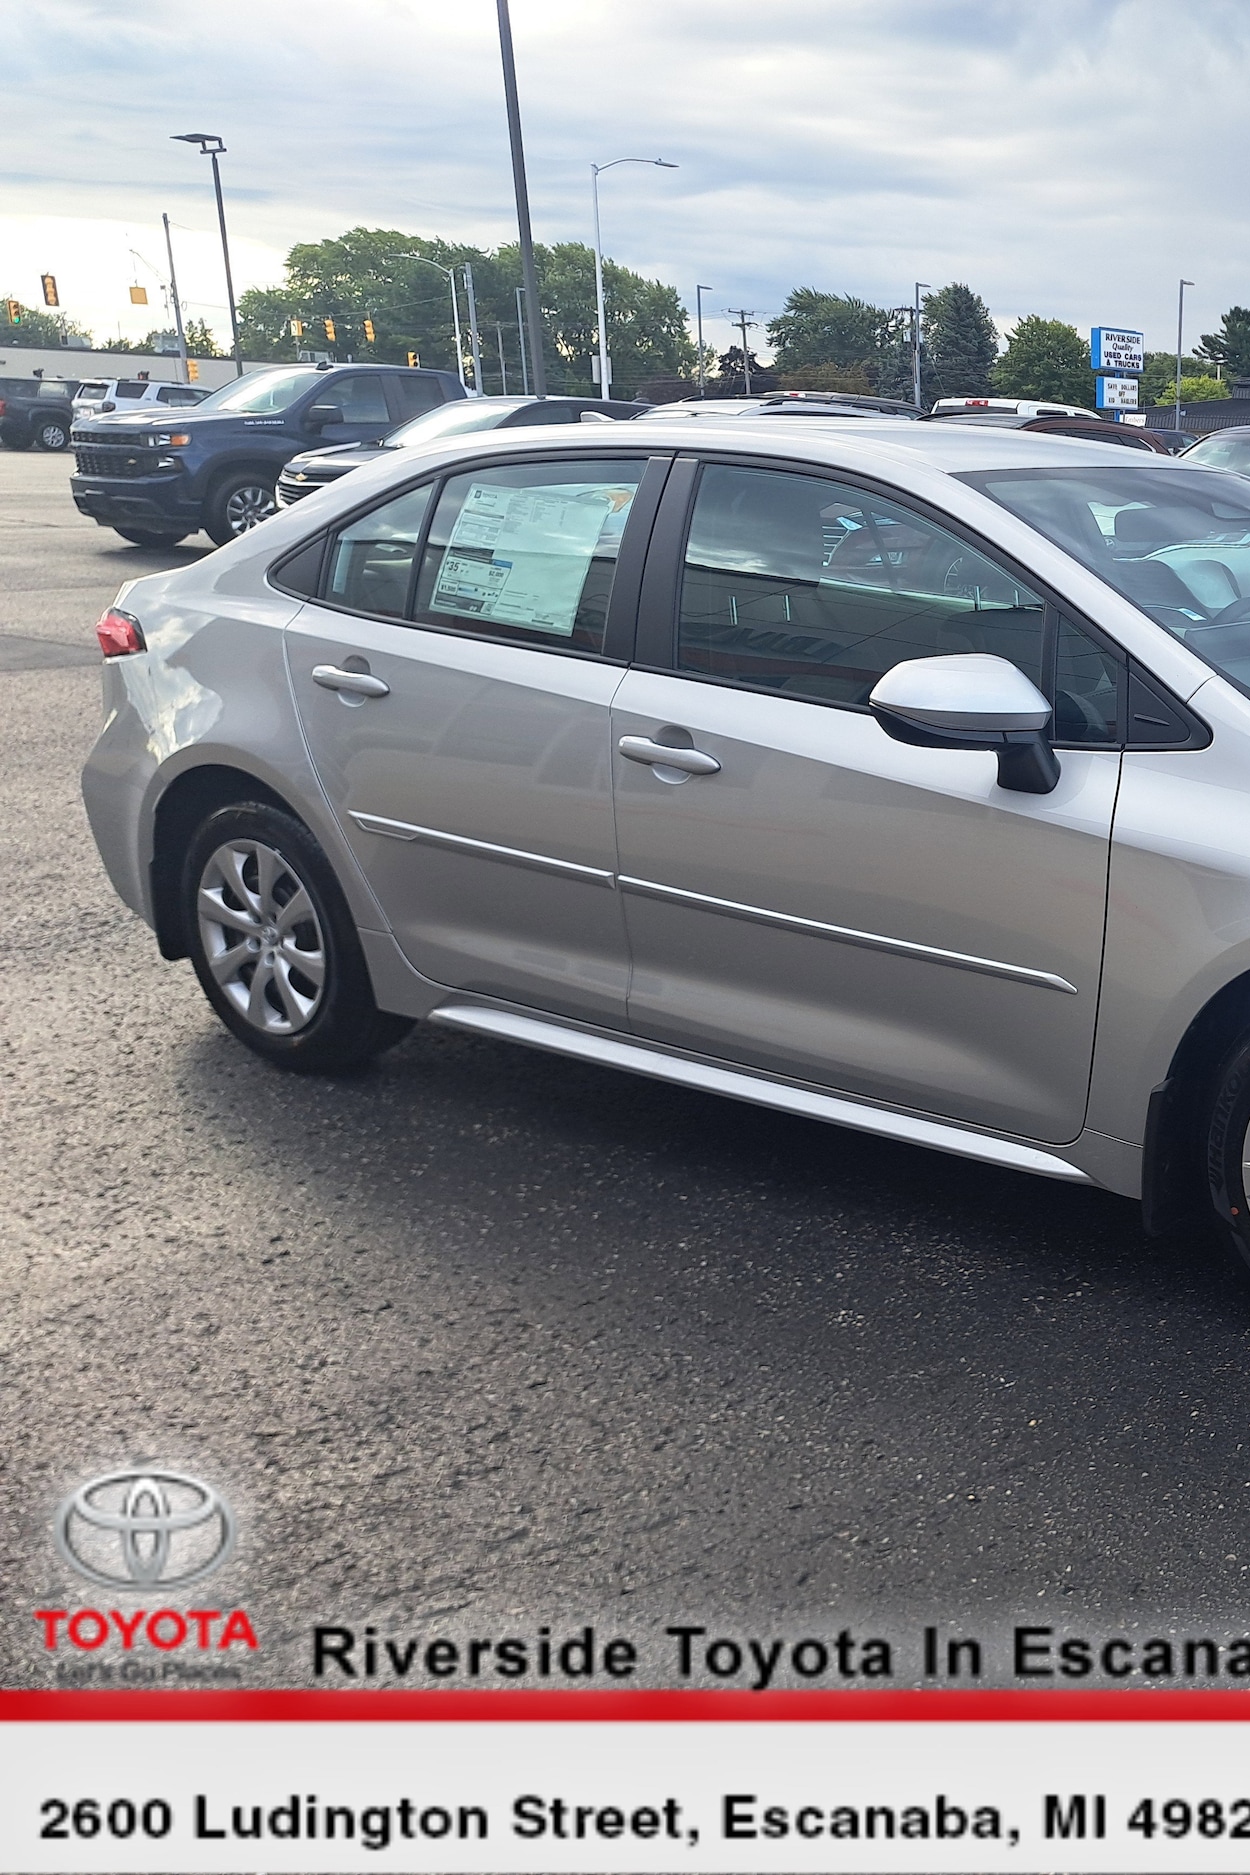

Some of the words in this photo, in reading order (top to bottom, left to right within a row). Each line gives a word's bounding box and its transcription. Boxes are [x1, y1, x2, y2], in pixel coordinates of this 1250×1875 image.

[1105, 333, 1141, 344] RIVERSIDE
[1112, 343, 1134, 353] Quality
[1104, 351, 1121, 359] USED
[1124, 353, 1142, 361] CARS
[1114, 360, 1140, 369] TRUCKS
